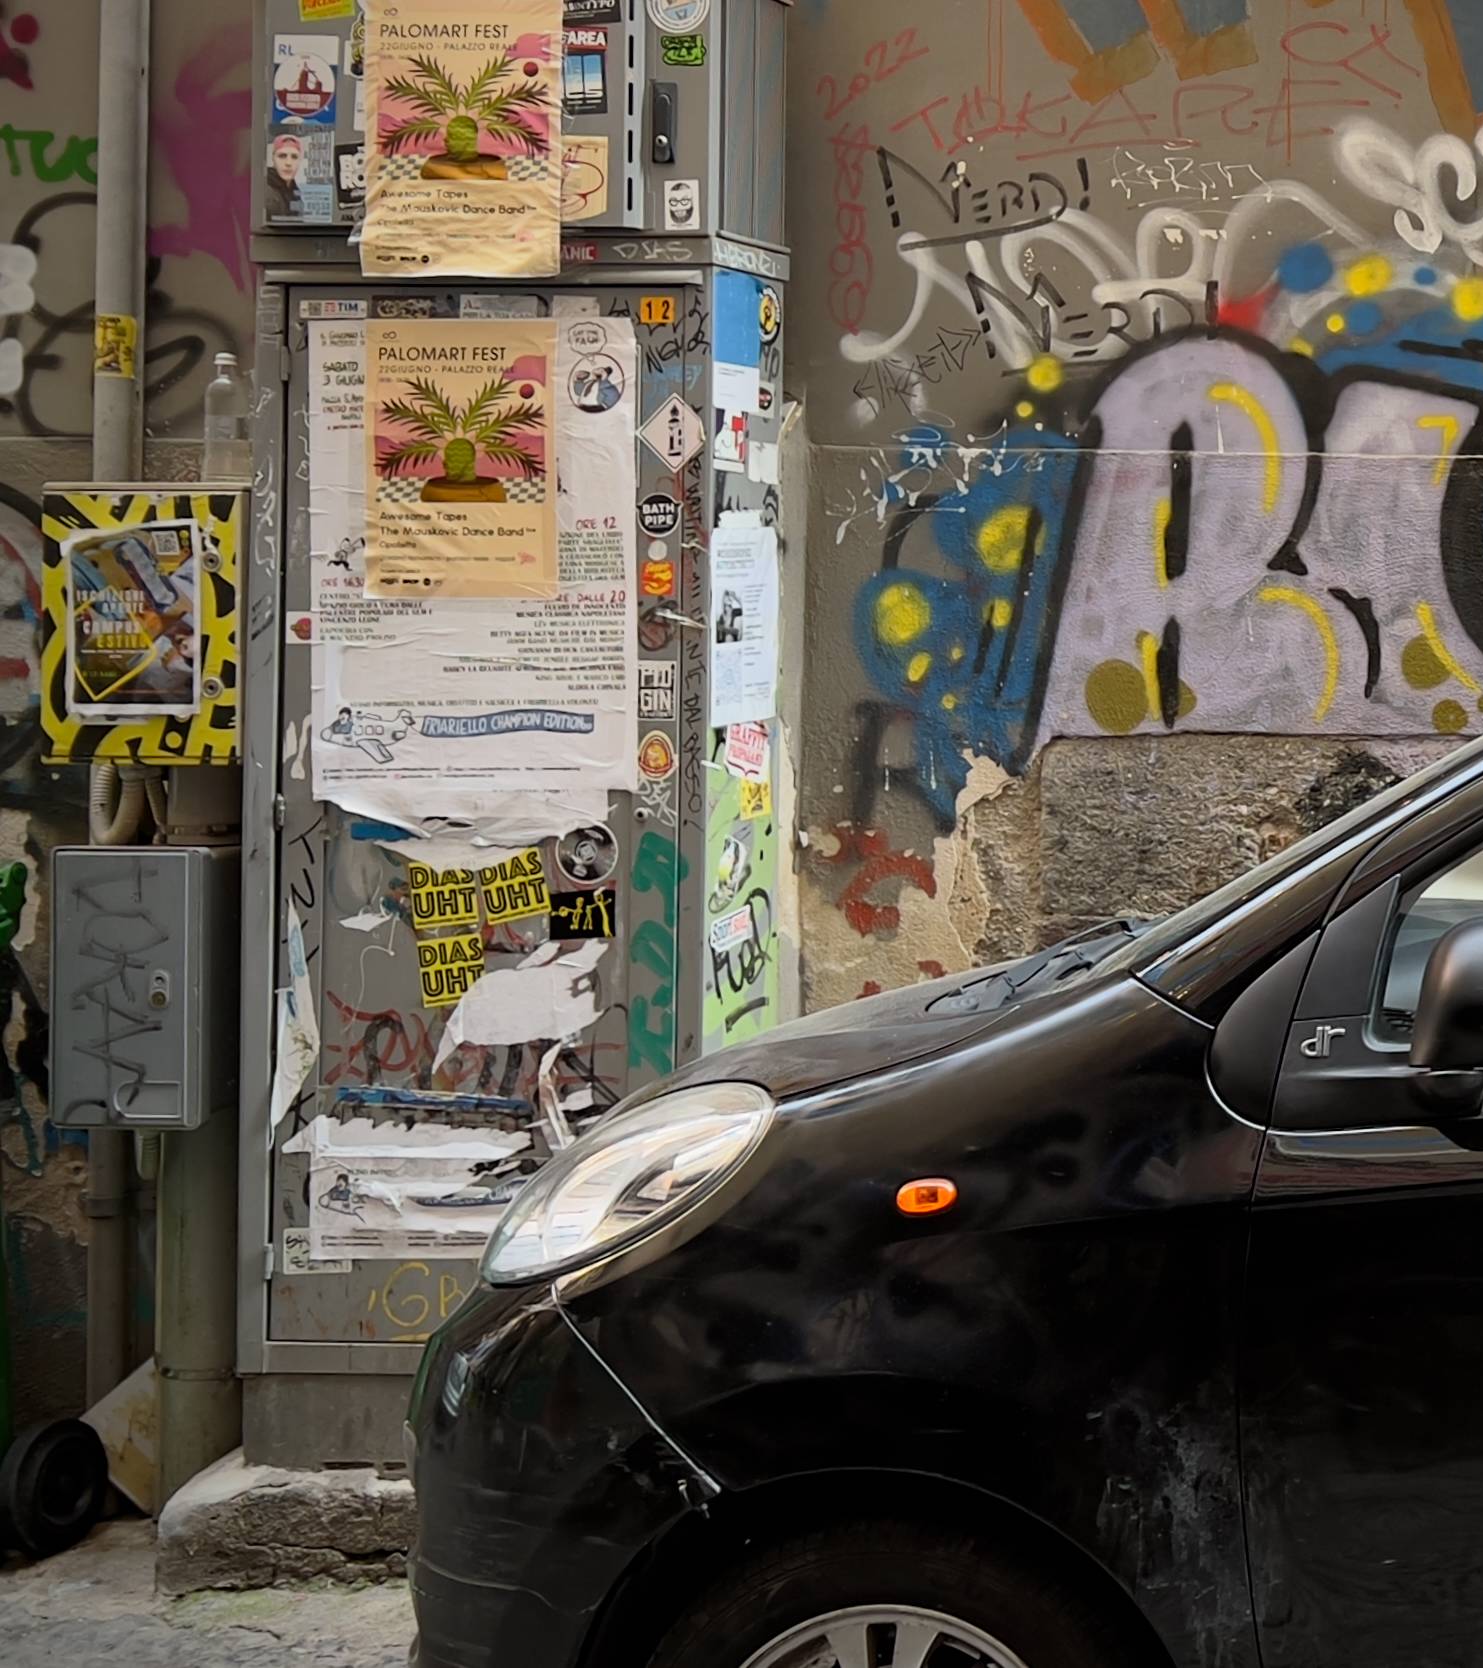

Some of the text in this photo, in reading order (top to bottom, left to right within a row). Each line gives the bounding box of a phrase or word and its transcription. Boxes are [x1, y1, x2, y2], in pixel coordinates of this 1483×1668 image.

[380, 24, 509, 39] PALOMART FEST
[380, 42, 434, 51] 22GIUGNO
[443, 42, 486, 51] PALAZZO
[380, 189, 468, 200] Awesome Tapes
[463, 204, 495, 214] Dance
[498, 204, 525, 214] Band
[337, 303, 358, 313] TIM
[379, 347, 507, 361] PALOMART FEST
[379, 366, 432, 374] 22GIUGNO
[441, 366, 483, 374] PALAZZO
[335, 374, 366, 386] GIUGN
[642, 503, 675, 515] BATH
[379, 512, 468, 522] Awesome Tapes
[603, 516, 616, 530] 12
[644, 515, 674, 526] PIPE
[380, 527, 399, 536] The
[462, 528, 494, 536] Dance
[497, 528, 524, 536] Band
[610, 590, 626, 603] 20
[640, 690, 672, 710] GIN
[423, 716, 488, 736] FRIARIELLO
[490, 712, 540, 731] CHAMPION
[479, 851, 543, 886] DIAS
[483, 877, 546, 915] UHT
[413, 886, 476, 919] UHT
[417, 937, 484, 968] DIAS
